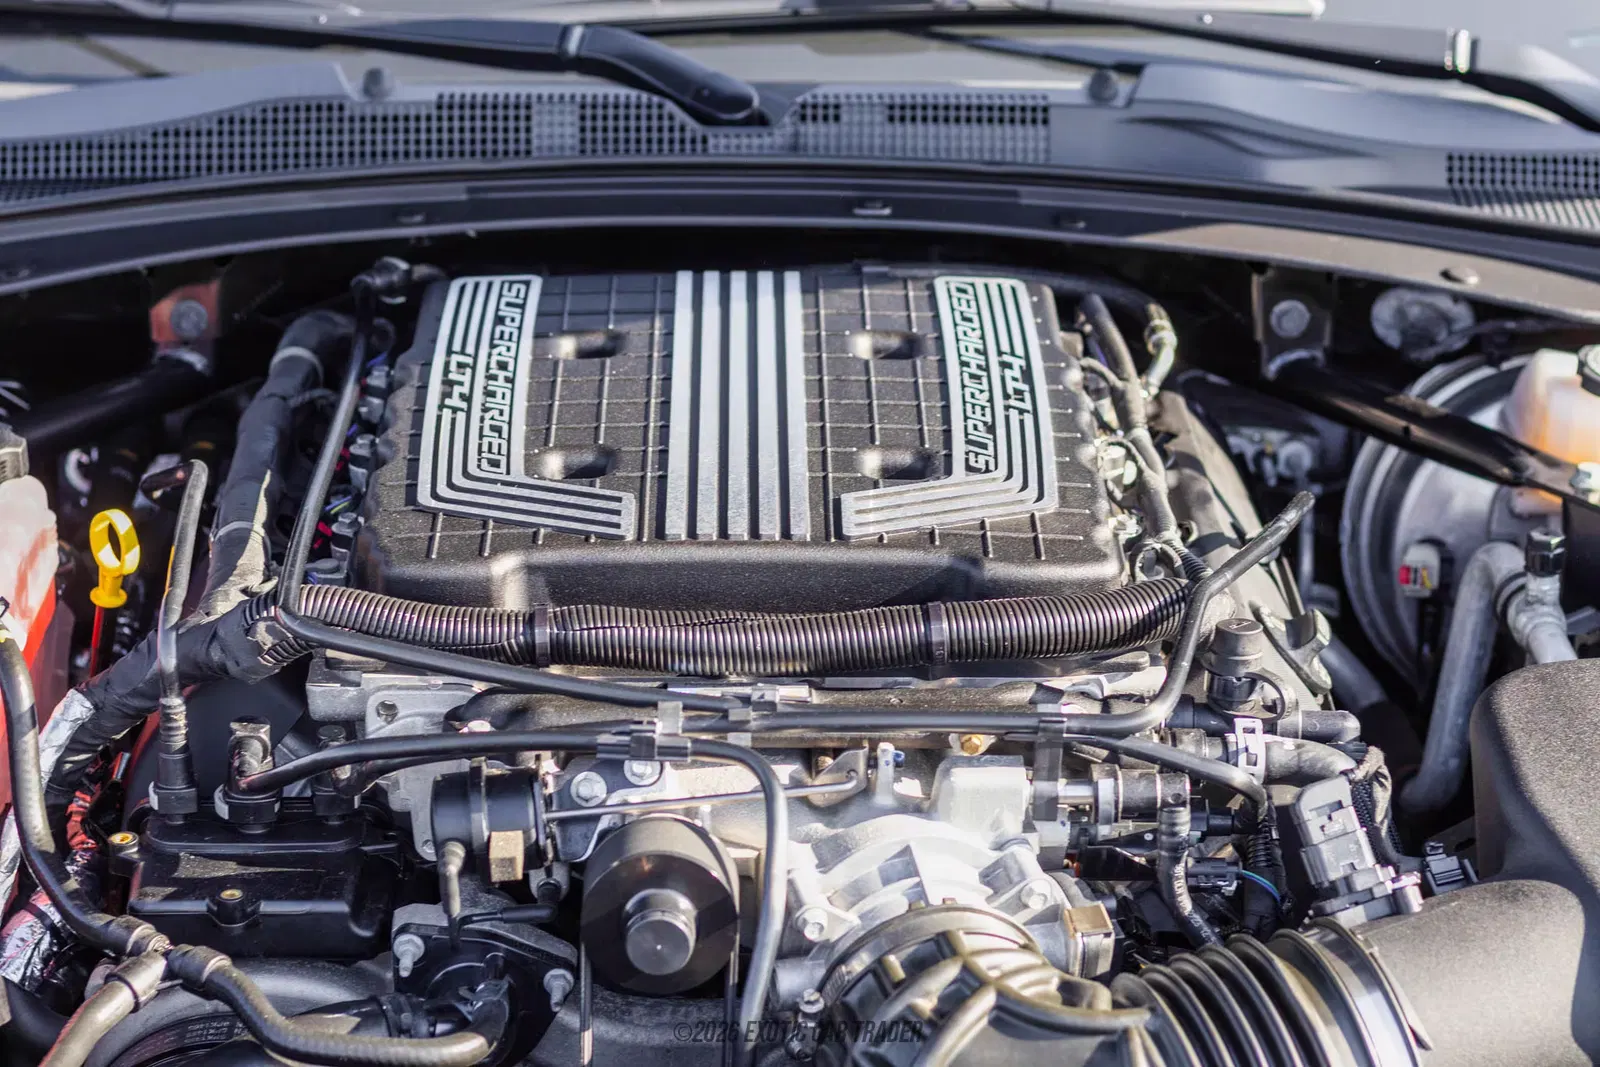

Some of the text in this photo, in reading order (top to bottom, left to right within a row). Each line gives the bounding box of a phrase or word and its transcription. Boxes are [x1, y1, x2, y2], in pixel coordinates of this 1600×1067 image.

[443, 353, 474, 412] LT4
[480, 280, 528, 476] SUPERCHARGED
[950, 280, 997, 473] SUPERCHARGED
[1001, 353, 1033, 415] LT4
